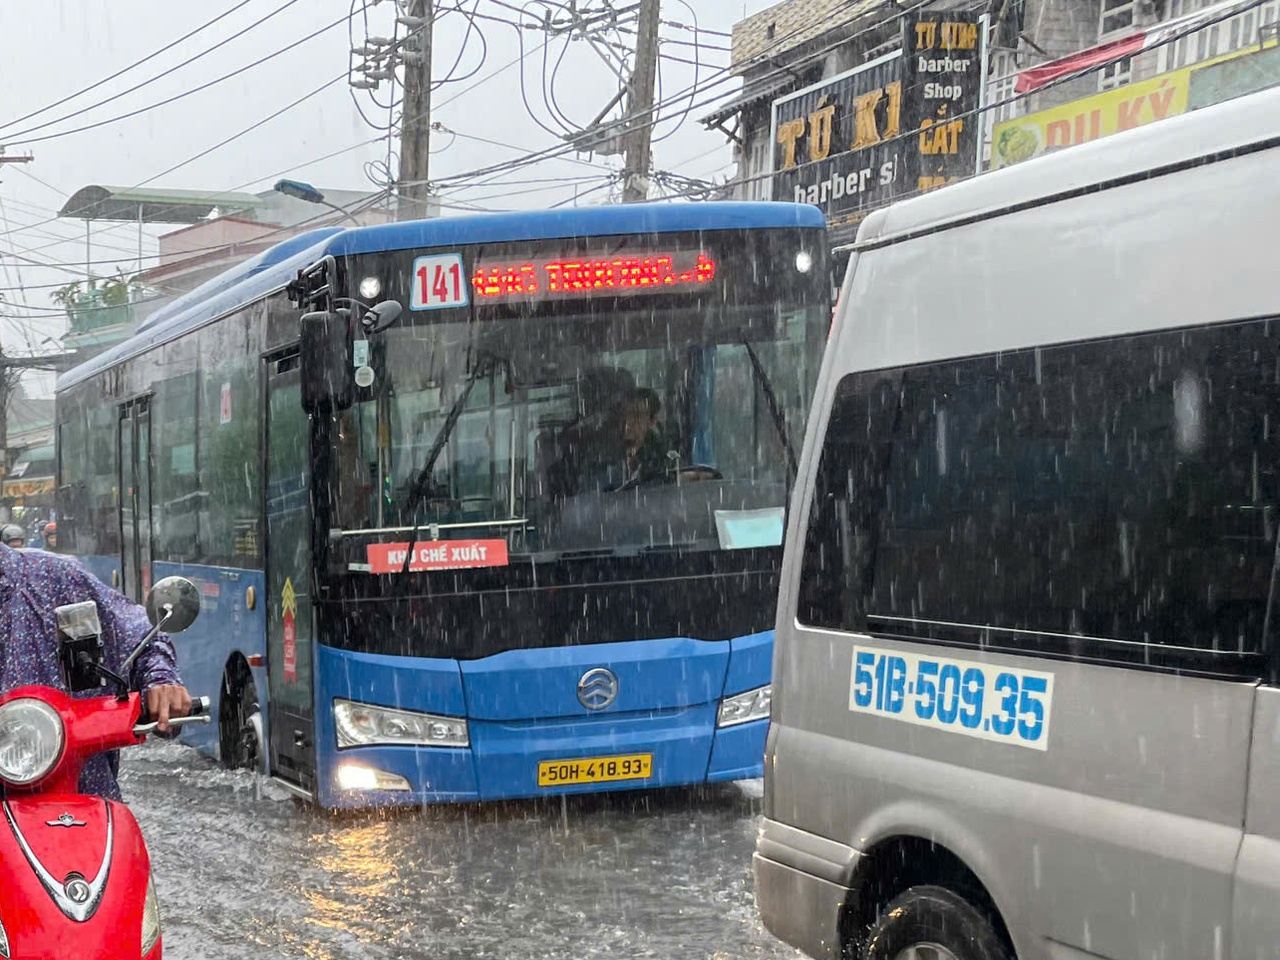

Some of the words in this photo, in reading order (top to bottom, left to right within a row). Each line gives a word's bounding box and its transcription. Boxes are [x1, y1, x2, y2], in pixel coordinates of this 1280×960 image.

[918, 57, 970, 73] barber
[923, 83, 963, 101] Shop
[793, 167, 871, 205] barber
[416, 263, 461, 305] 141
[420, 544, 448, 562] CHẾ
[451, 543, 488, 562] XUẤT
[548, 759, 642, 781] 50H-418.93
